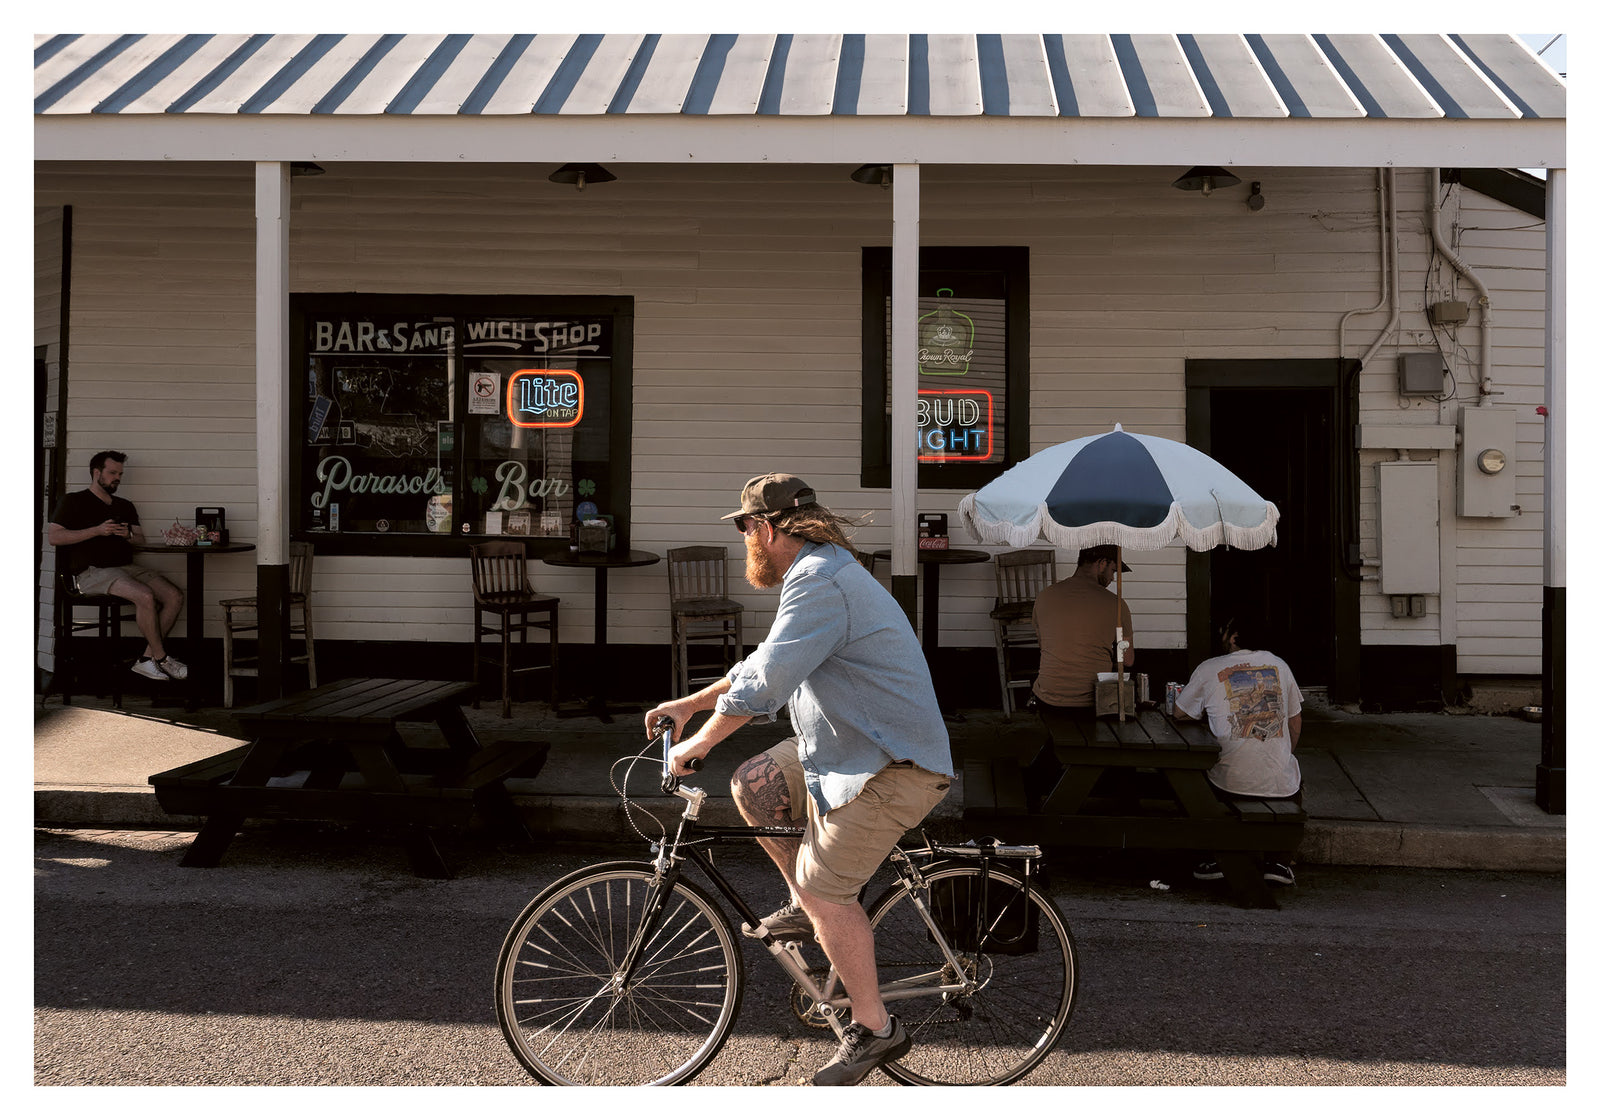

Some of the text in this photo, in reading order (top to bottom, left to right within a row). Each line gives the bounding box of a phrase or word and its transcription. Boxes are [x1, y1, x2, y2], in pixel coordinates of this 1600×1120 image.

[533, 322, 601, 352] SHOP
[917, 348, 974, 365] Crown Royal
[519, 377, 578, 415] Lite
[546, 408, 579, 418] ON TAP
[917, 399, 980, 427] BUD
[917, 428, 986, 451] IGHT
[489, 460, 569, 512] Bar
